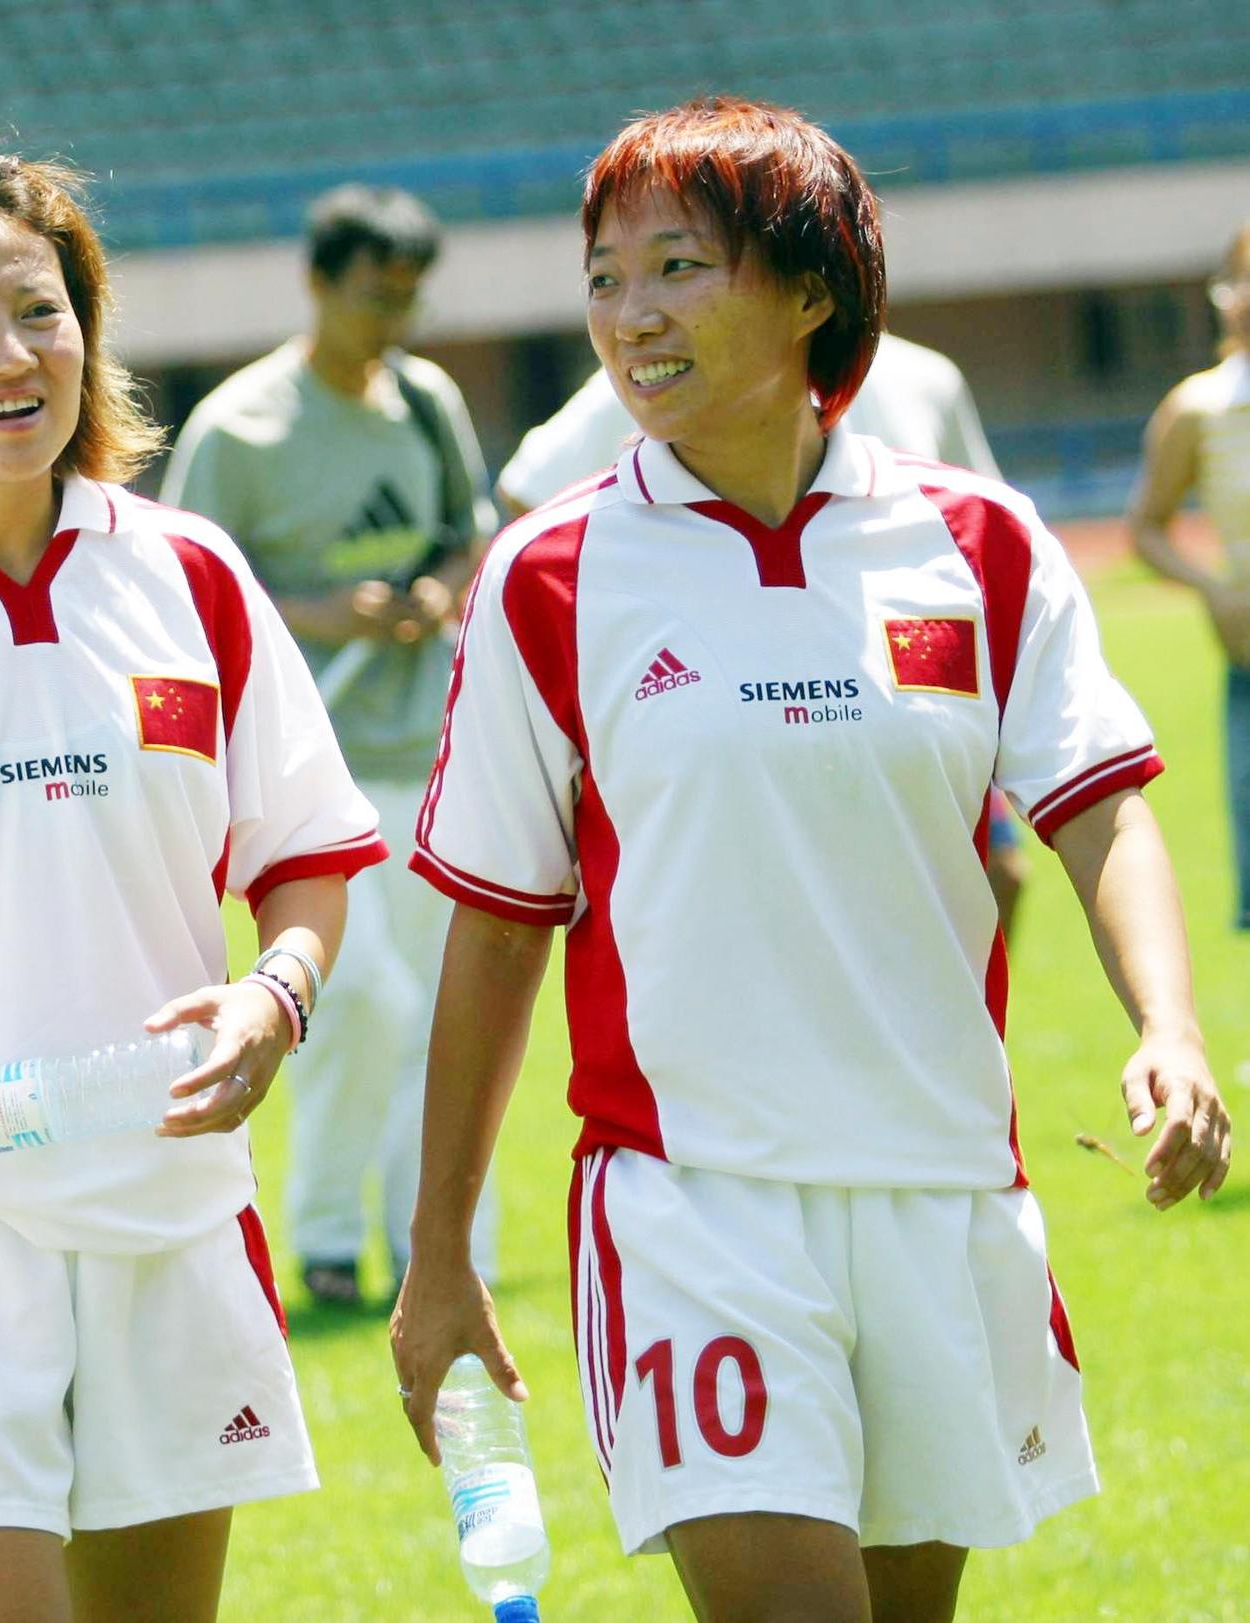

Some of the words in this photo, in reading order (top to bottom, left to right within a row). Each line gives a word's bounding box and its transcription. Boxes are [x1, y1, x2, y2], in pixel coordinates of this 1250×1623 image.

[634, 670, 702, 701] adidas
[739, 678, 860, 702] SIEMENS
[783, 703, 863, 724] mobile
[0, 753, 108, 784] SIEMENS
[633, 1331, 771, 1471] 10
[219, 1425, 270, 1445] adidas
